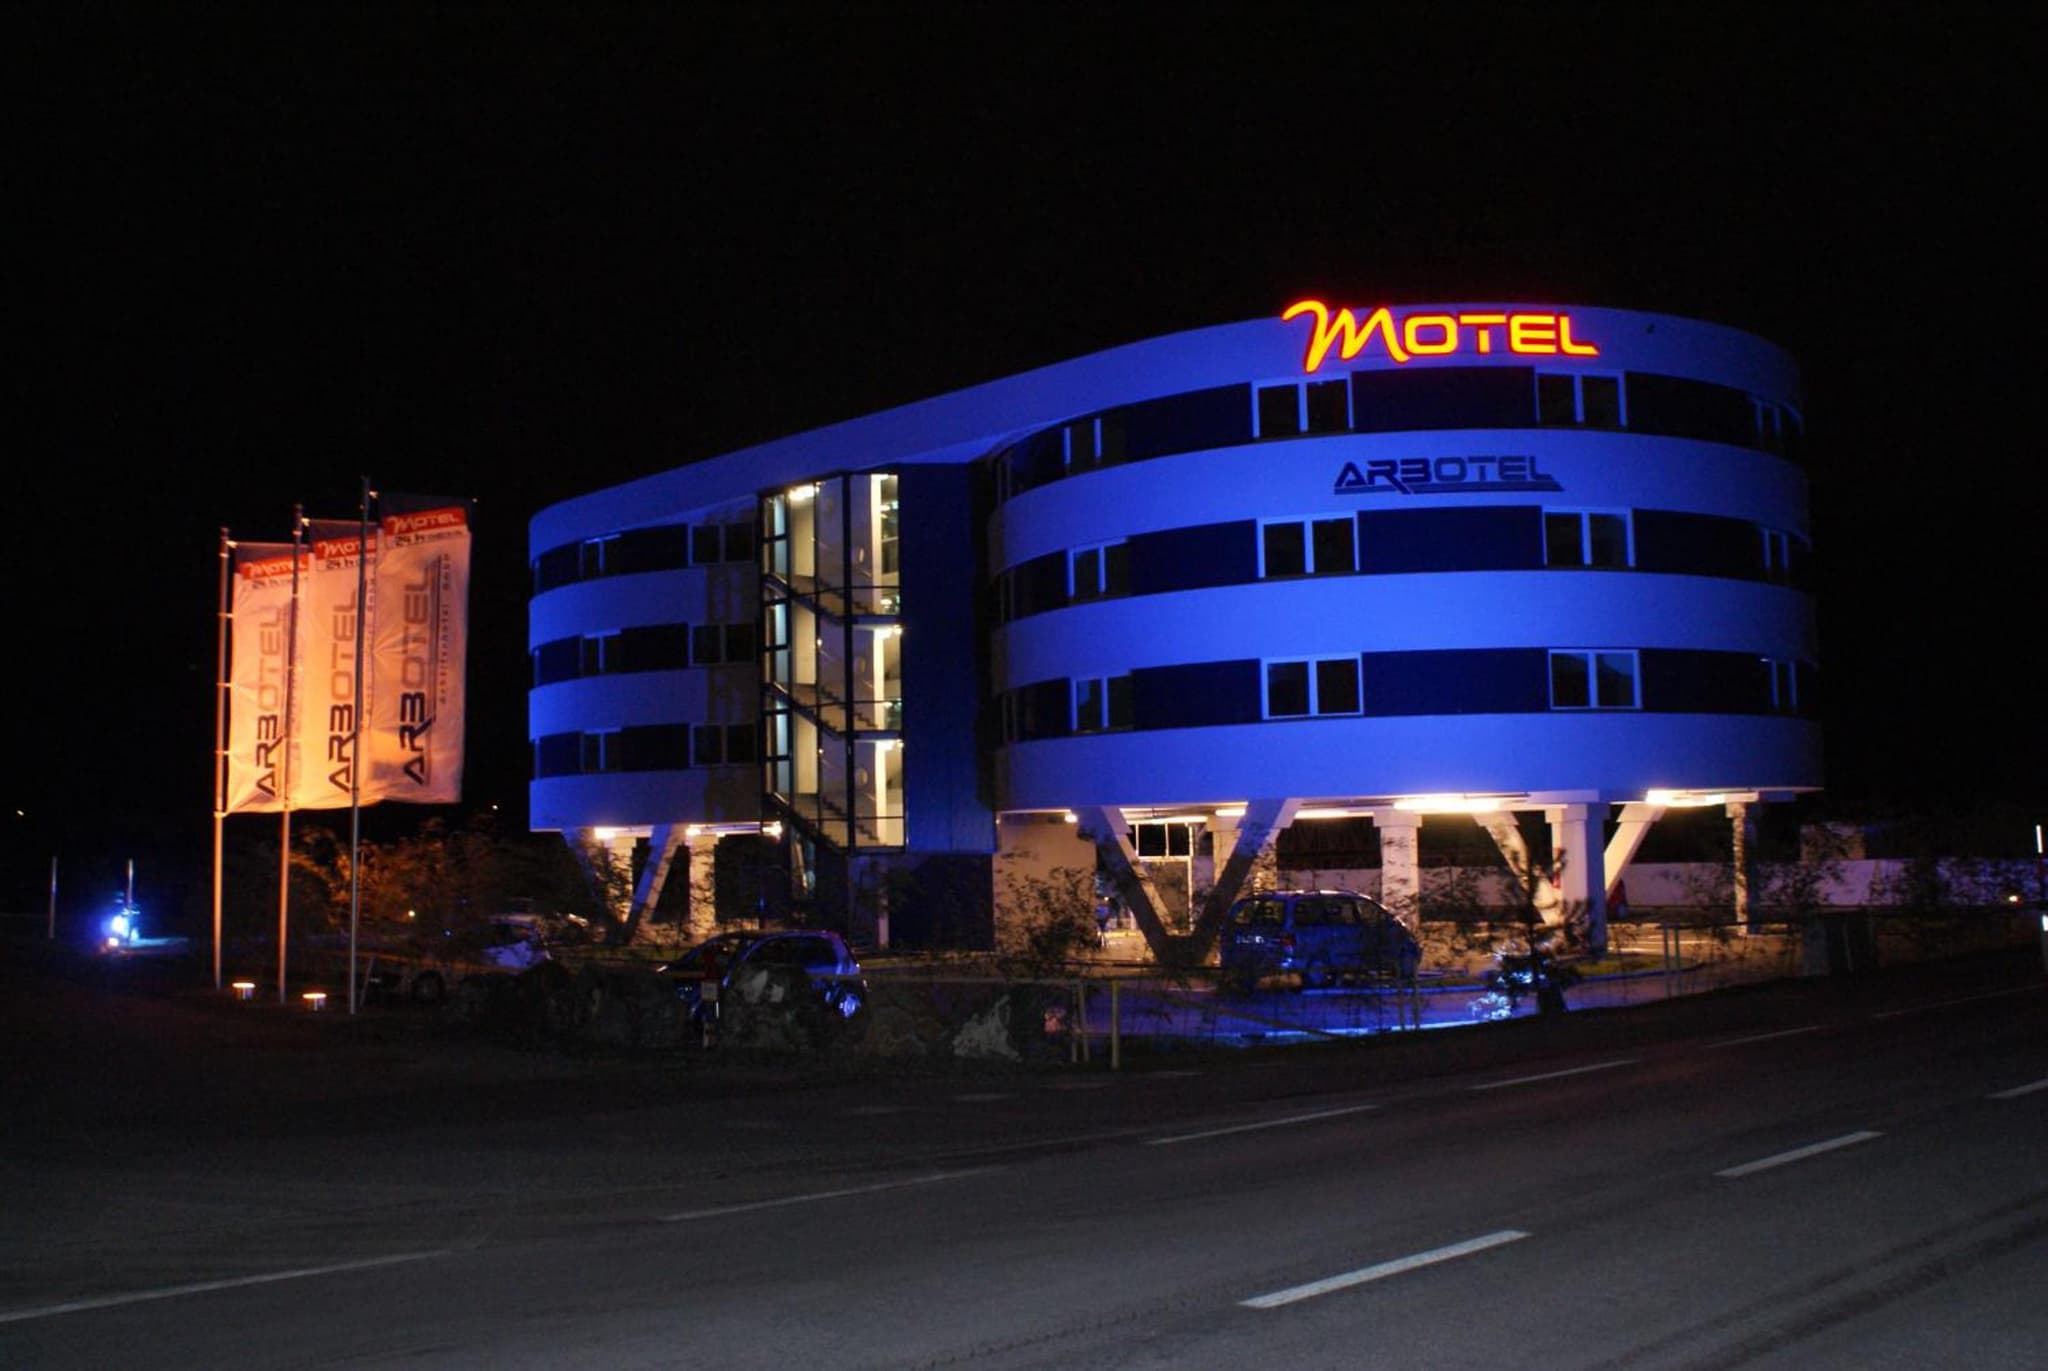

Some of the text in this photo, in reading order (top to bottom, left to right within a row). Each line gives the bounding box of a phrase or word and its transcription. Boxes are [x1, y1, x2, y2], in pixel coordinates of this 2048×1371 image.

[1282, 299, 1600, 374] MOTEL
[386, 513, 460, 534] MOTEL
[1334, 455, 1564, 493] ARBOTEL
[256, 606, 284, 796] ARBOTEL
[328, 590, 357, 794] ARBOTEL
[400, 566, 434, 785] ARBOTEL
